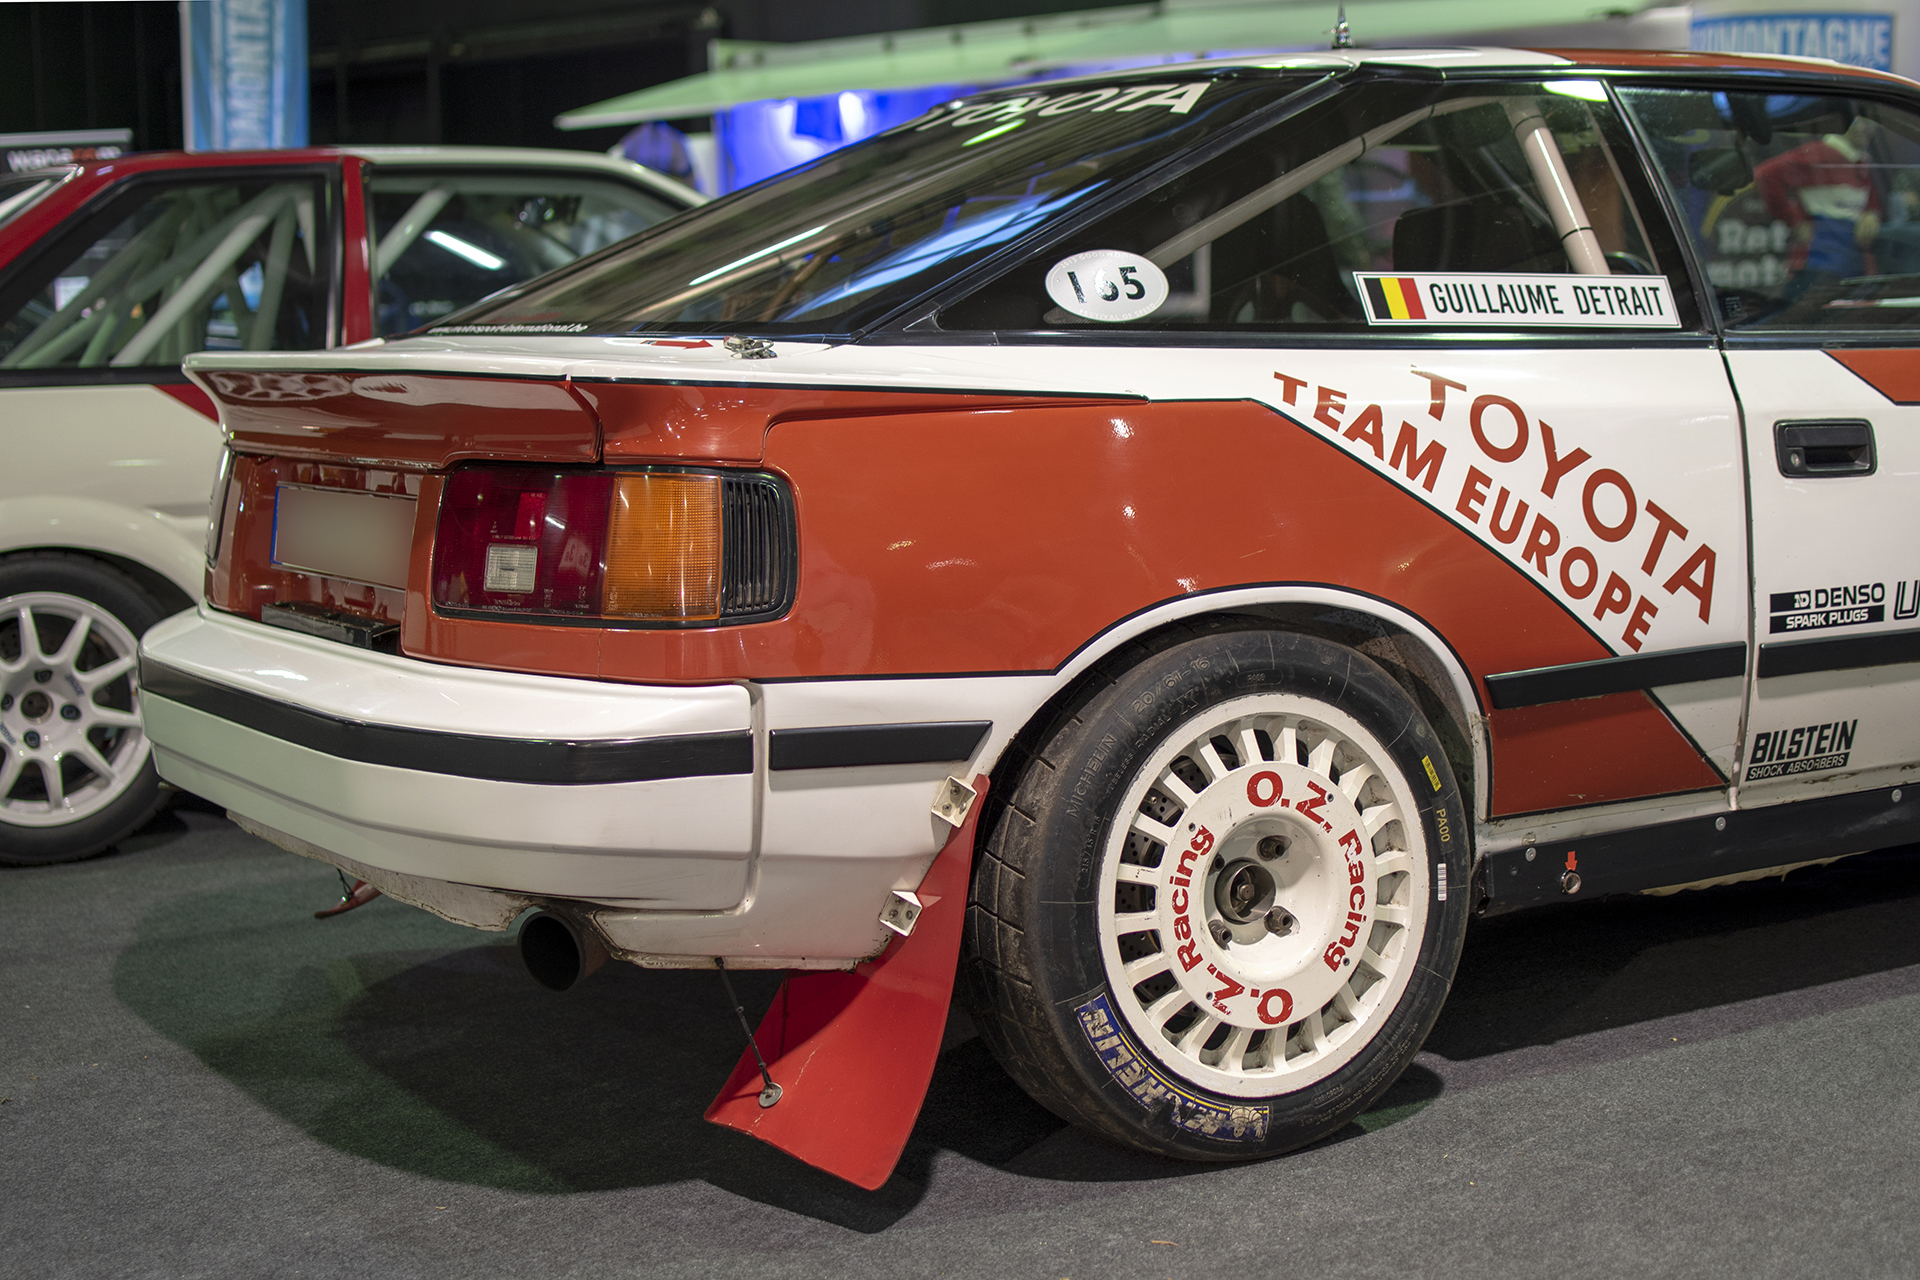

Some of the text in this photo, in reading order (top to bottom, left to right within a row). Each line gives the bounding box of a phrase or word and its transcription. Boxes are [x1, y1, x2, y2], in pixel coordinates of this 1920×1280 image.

[1066, 265, 1146, 304] 165
[1428, 282, 1665, 316] GUILLAUME DETRAIT
[1122, 311, 1134, 320] OF
[1134, 302, 1157, 316] SPEED
[1273, 371, 1659, 653] TEAM EUROPE
[1410, 364, 1717, 625] TOYOTA
[1814, 582, 1886, 609] DENSO
[1785, 608, 1869, 630] SPARK PLUGS
[1749, 719, 1859, 766] BILSTEIN
[1065, 732, 1118, 819] MICHELIN
[1748, 754, 1846, 780] SHOCK ABSORBERS
[1436, 807, 1451, 843] PA00
[1246, 770, 1333, 834] O.Z.
[1323, 828, 1368, 973] Racing
[1168, 824, 1294, 1025] O.Z. Racing
